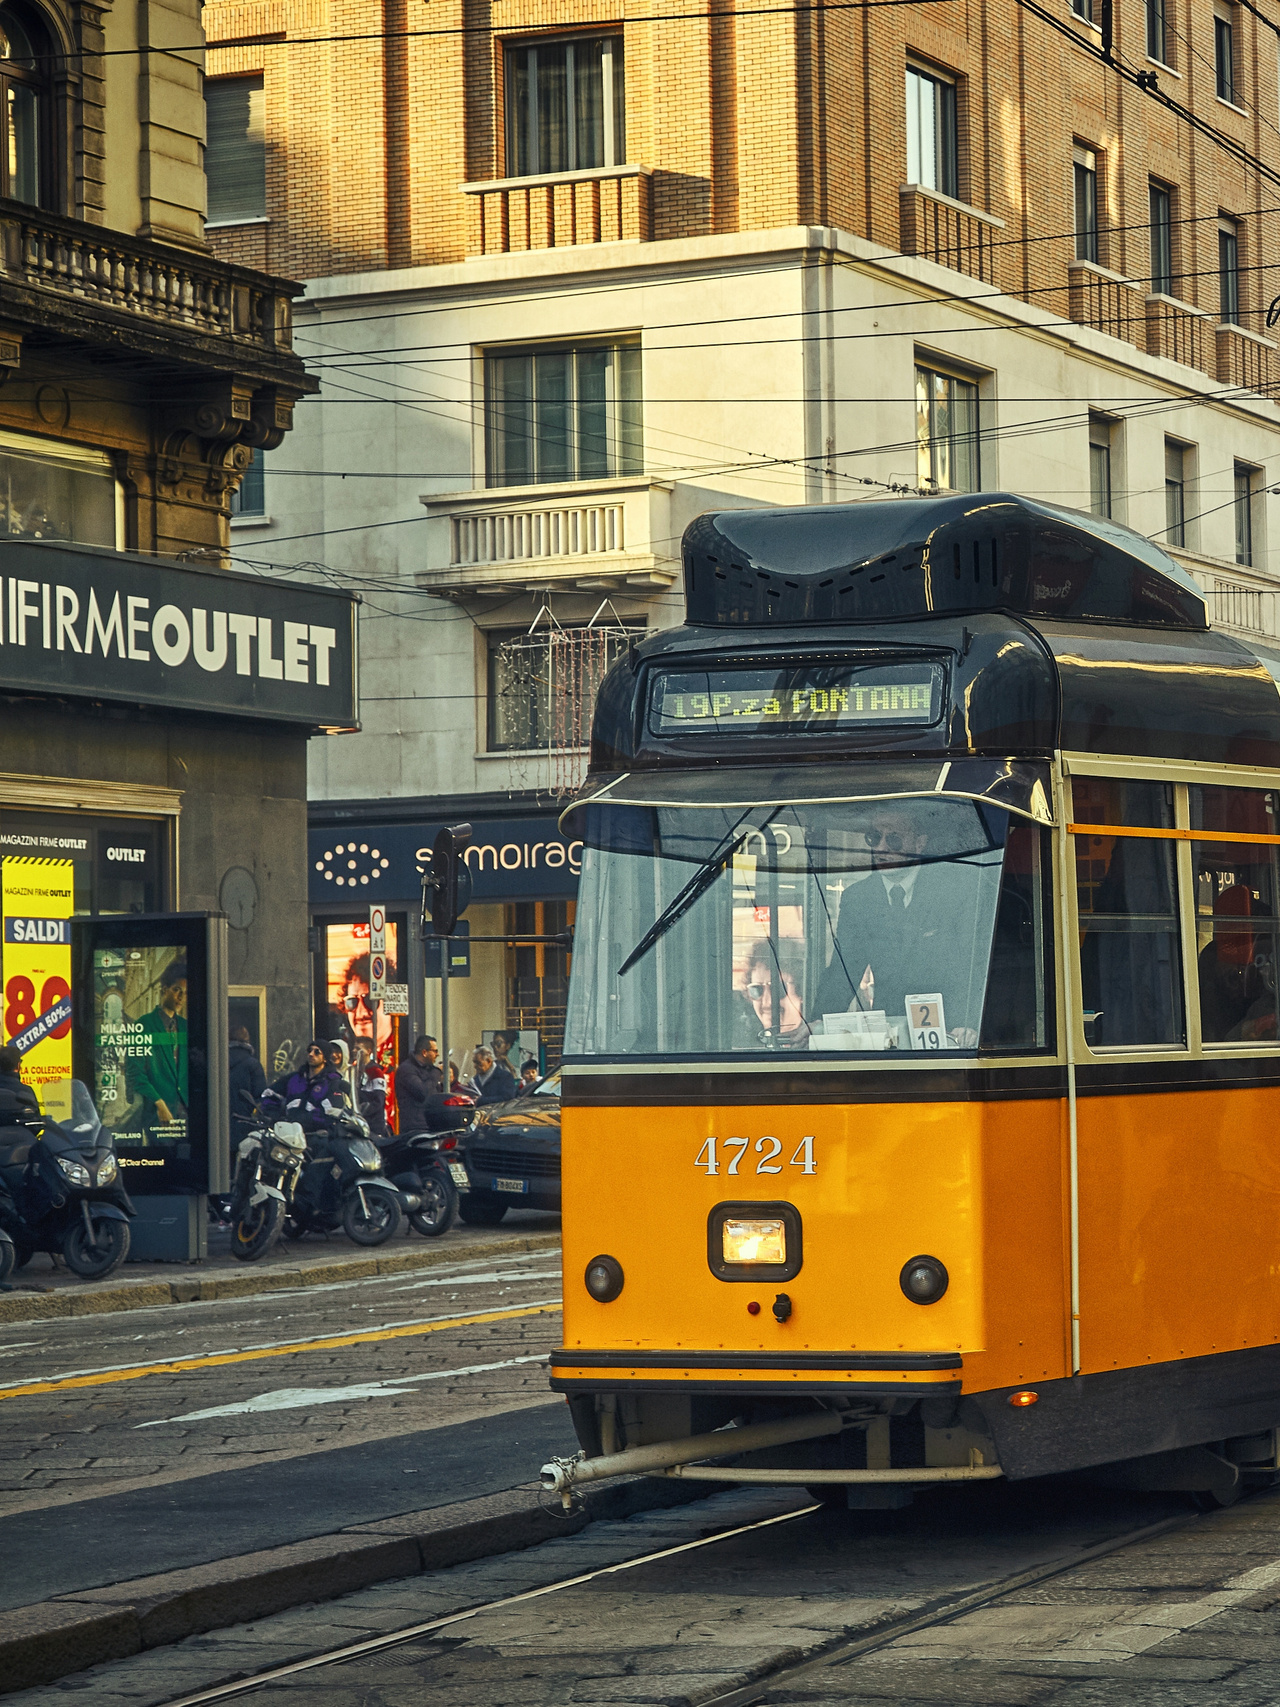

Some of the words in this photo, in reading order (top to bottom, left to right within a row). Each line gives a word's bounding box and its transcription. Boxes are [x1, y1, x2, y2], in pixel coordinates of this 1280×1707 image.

[0, 834, 39, 847] MAGAZZINI
[106, 847, 146, 863] OUTLET
[13, 919, 65, 942] SALDI
[919, 1005, 932, 1027] 2
[15, 1021, 47, 1051] EXTRA
[45, 1005, 67, 1028] 50%
[100, 1023, 144, 1033] MILANO
[100, 1034, 153, 1045] FASHION
[917, 1031, 940, 1050] 19
[114, 1046, 153, 1057] WEEK
[31, 1066, 71, 1074] COLLEZIONE
[101, 1089, 118, 1101] 20
[126, 1158, 141, 1166] Clear
[141, 1158, 165, 1166] Channel
[694, 1135, 818, 1176] 4724
